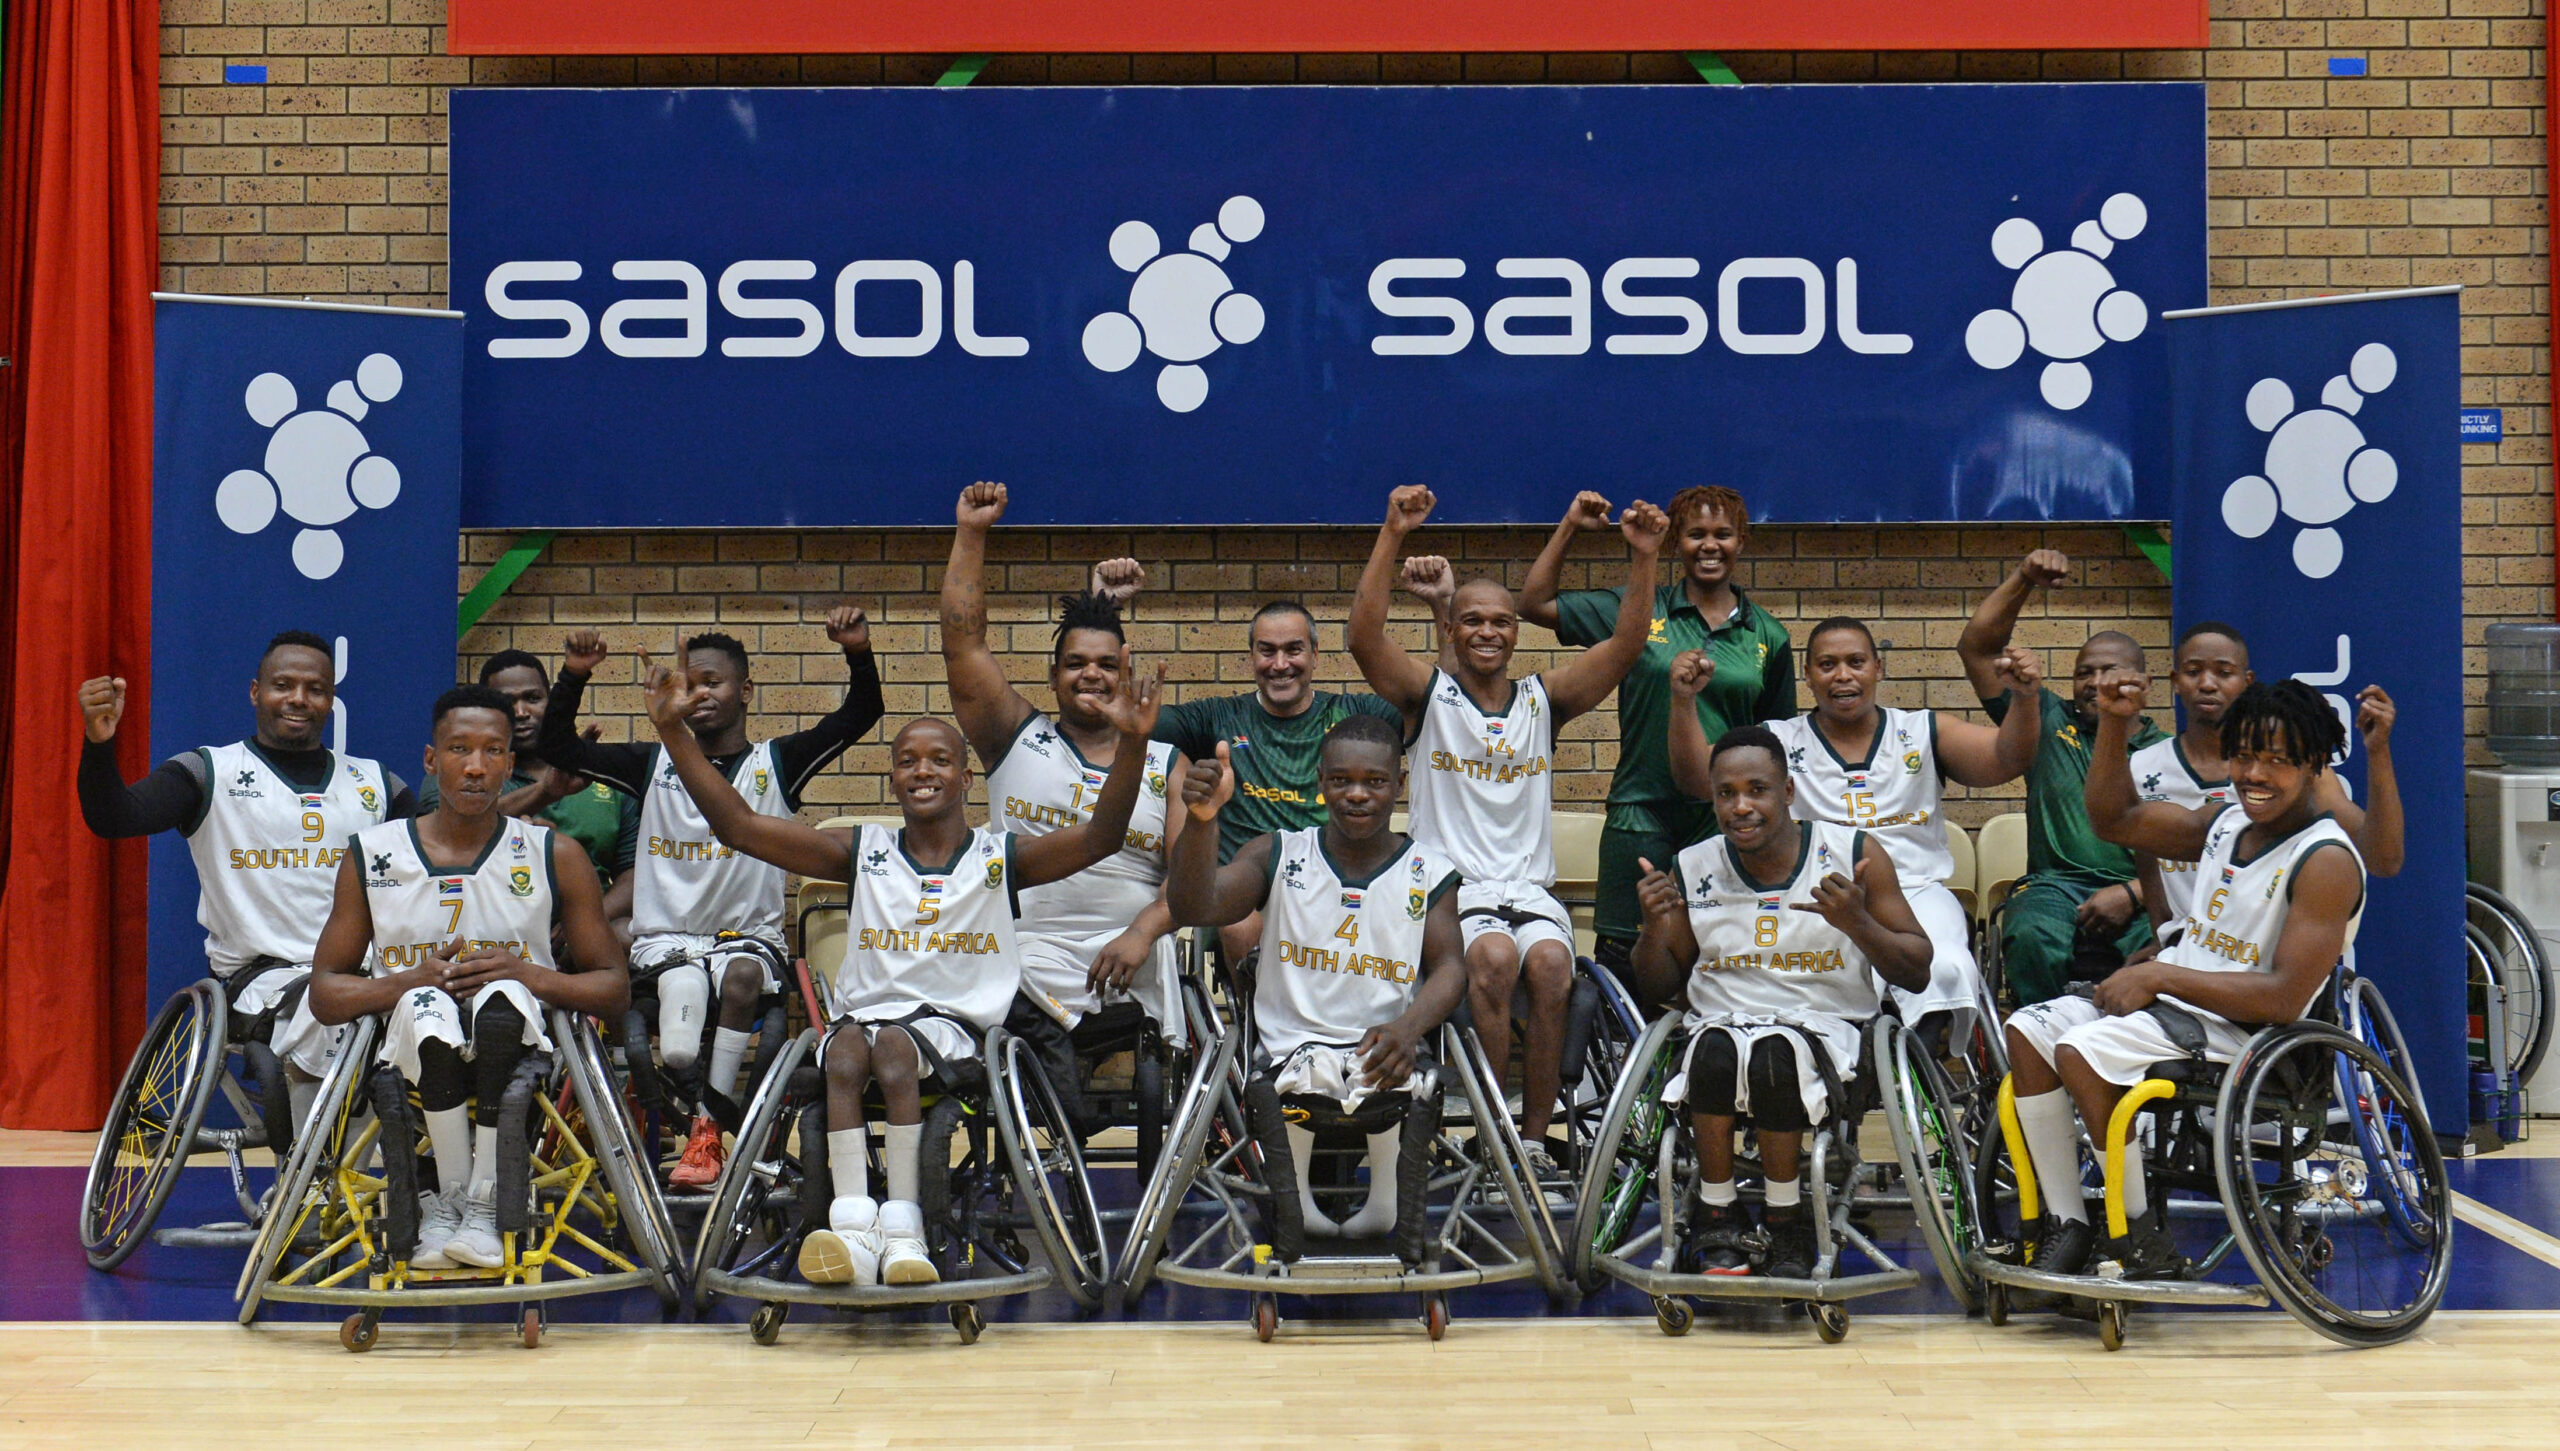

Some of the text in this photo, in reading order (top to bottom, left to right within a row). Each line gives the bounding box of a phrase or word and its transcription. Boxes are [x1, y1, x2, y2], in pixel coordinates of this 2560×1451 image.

[1482, 737, 1516, 760] 14
[1431, 751, 1493, 781] SOUTH
[1840, 791, 1877, 819] 15
[301, 811, 325, 843] 9
[1005, 796, 1164, 854] SOUTH RICA
[230, 848, 309, 869] SOUTH
[647, 835, 712, 861] SOUTH
[439, 898, 464, 934] 7
[915, 897, 941, 926] 5
[2206, 888, 2229, 921] 6
[925, 931, 1000, 955] AFRICA
[1334, 913, 1359, 947] 4
[1754, 915, 1779, 948] 8
[1768, 948, 1845, 973] AFRICA
[2200, 928, 2260, 966] AFRICA
[1343, 953, 1417, 985] AFRICA
